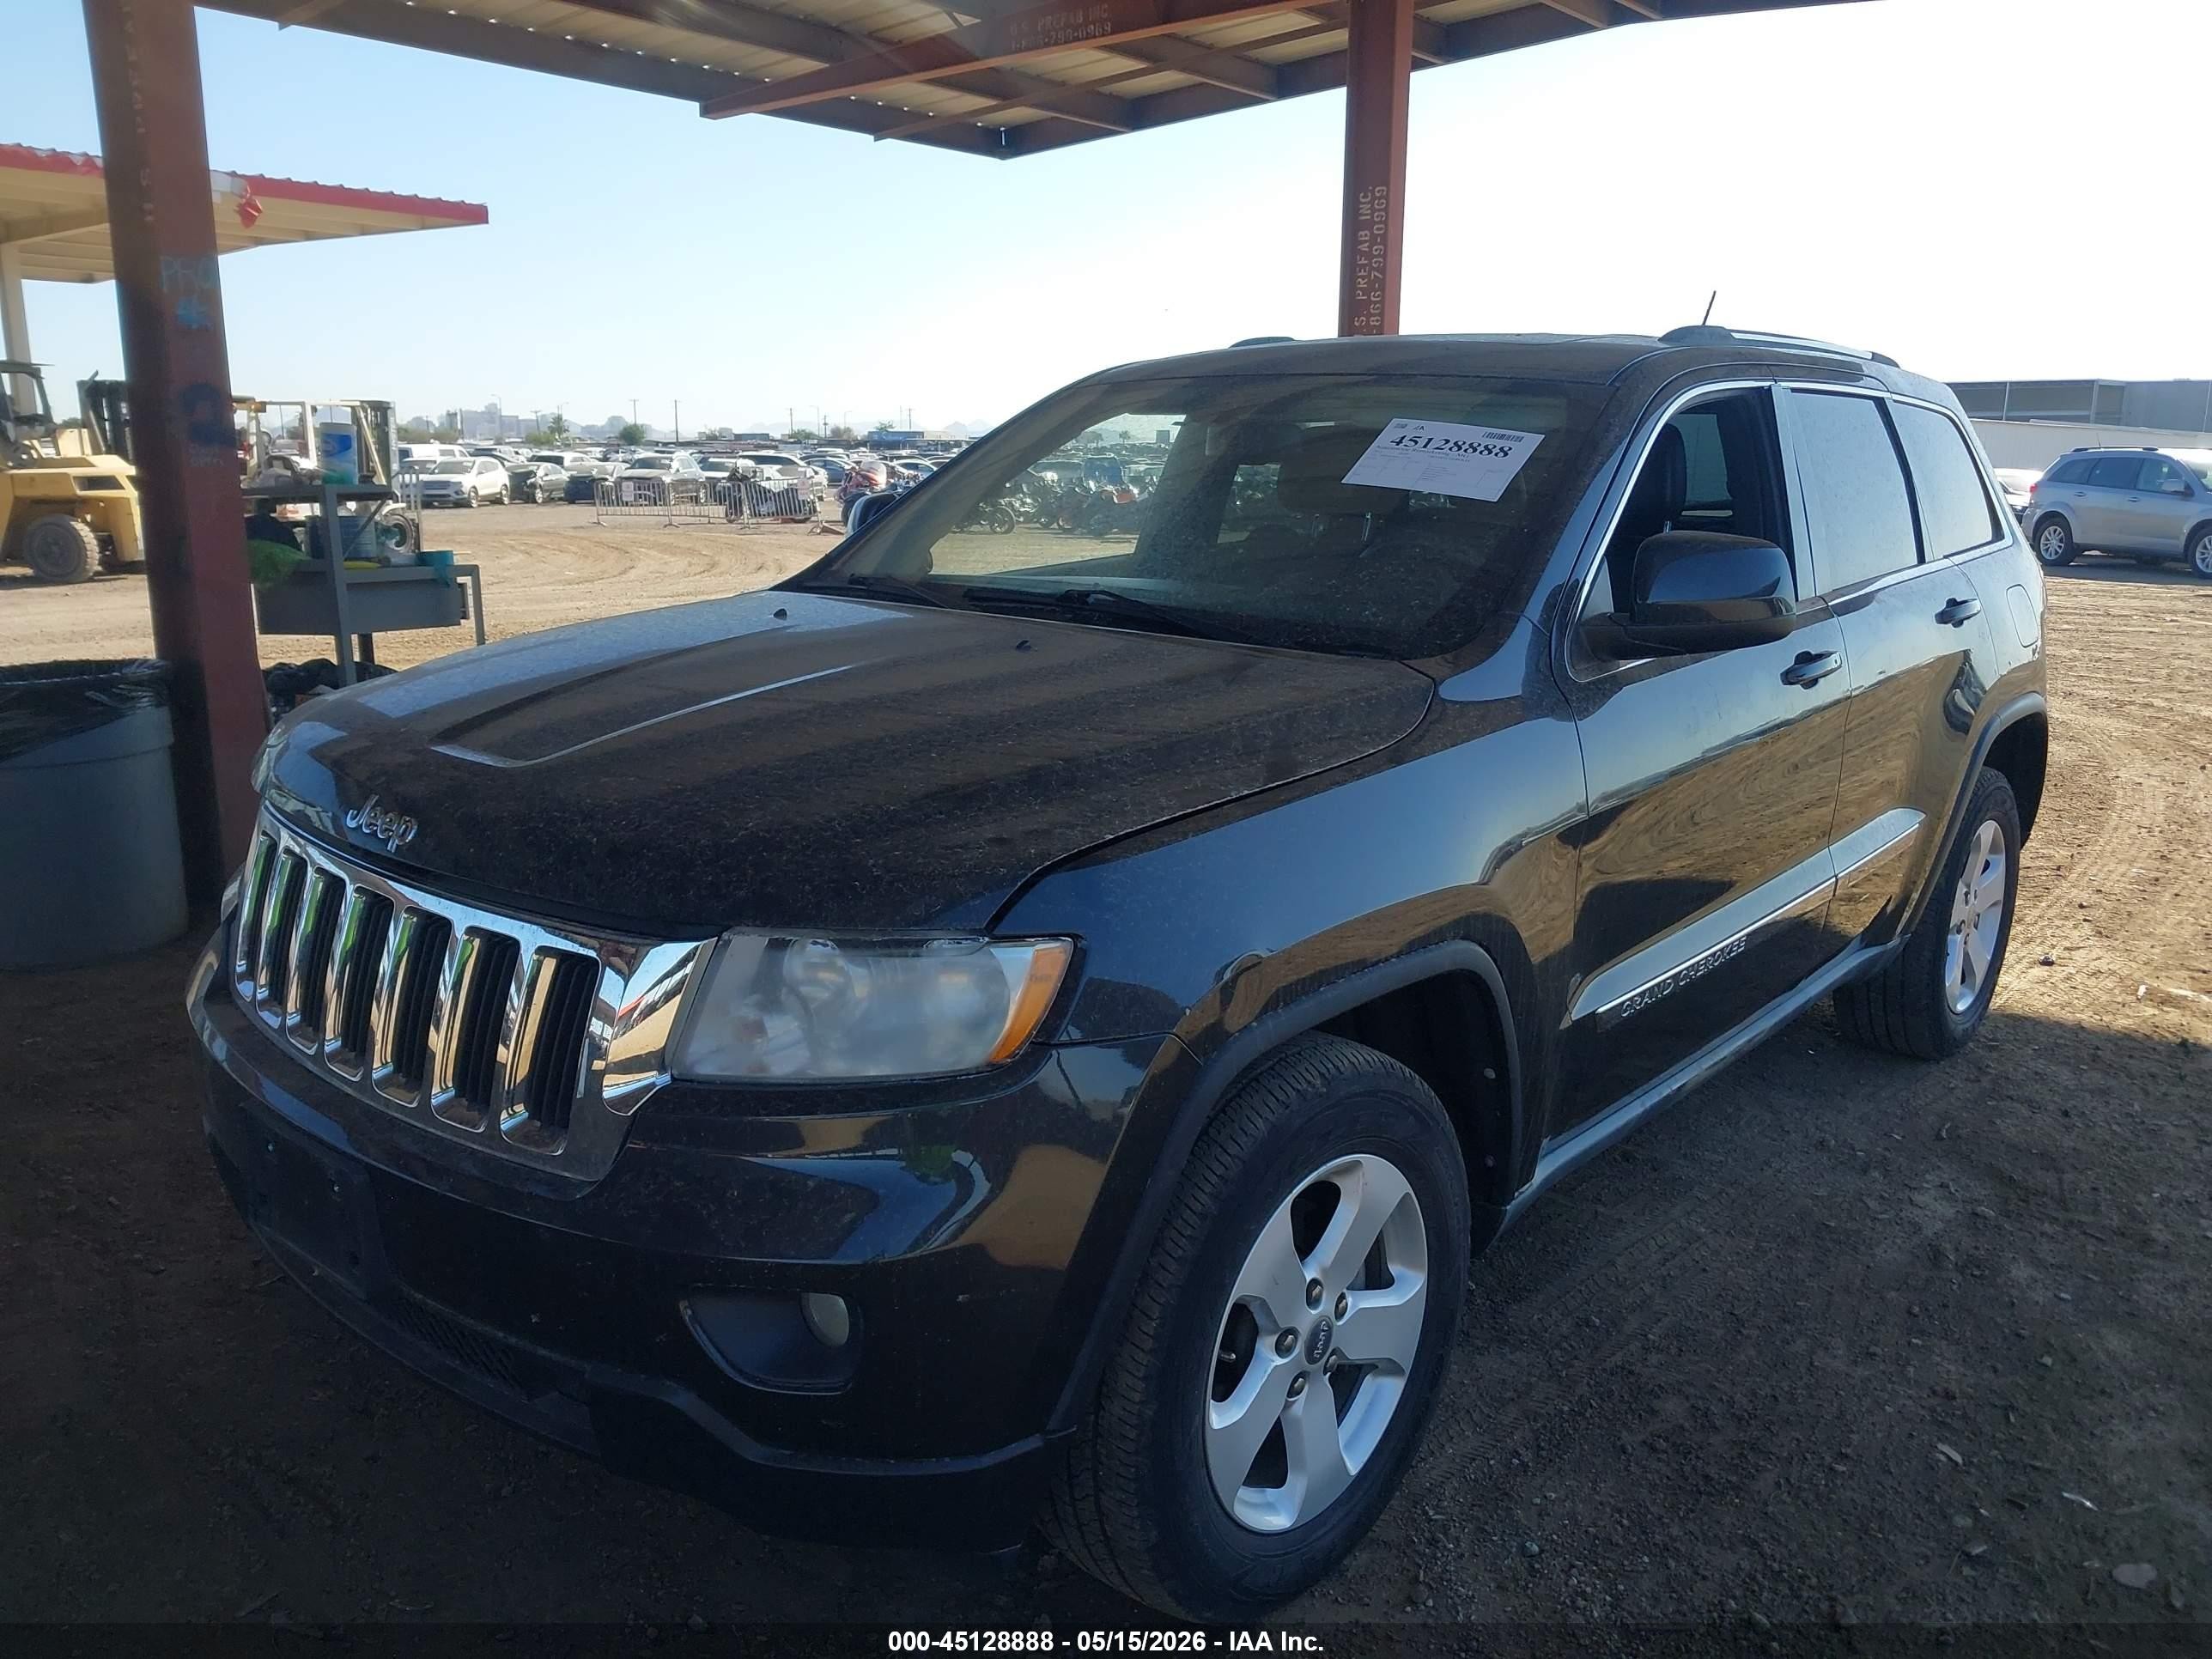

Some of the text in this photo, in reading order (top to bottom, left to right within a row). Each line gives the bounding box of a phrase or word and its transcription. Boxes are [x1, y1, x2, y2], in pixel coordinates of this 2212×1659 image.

[1354, 185, 1373, 333] .S. PREFAB INC.
[1370, 185, 1387, 334] -866-799-0969
[1389, 434, 1513, 459] 45128888
[346, 794, 418, 853] Jeep
[1621, 935, 1747, 1017] GRAND CHEROKEE
